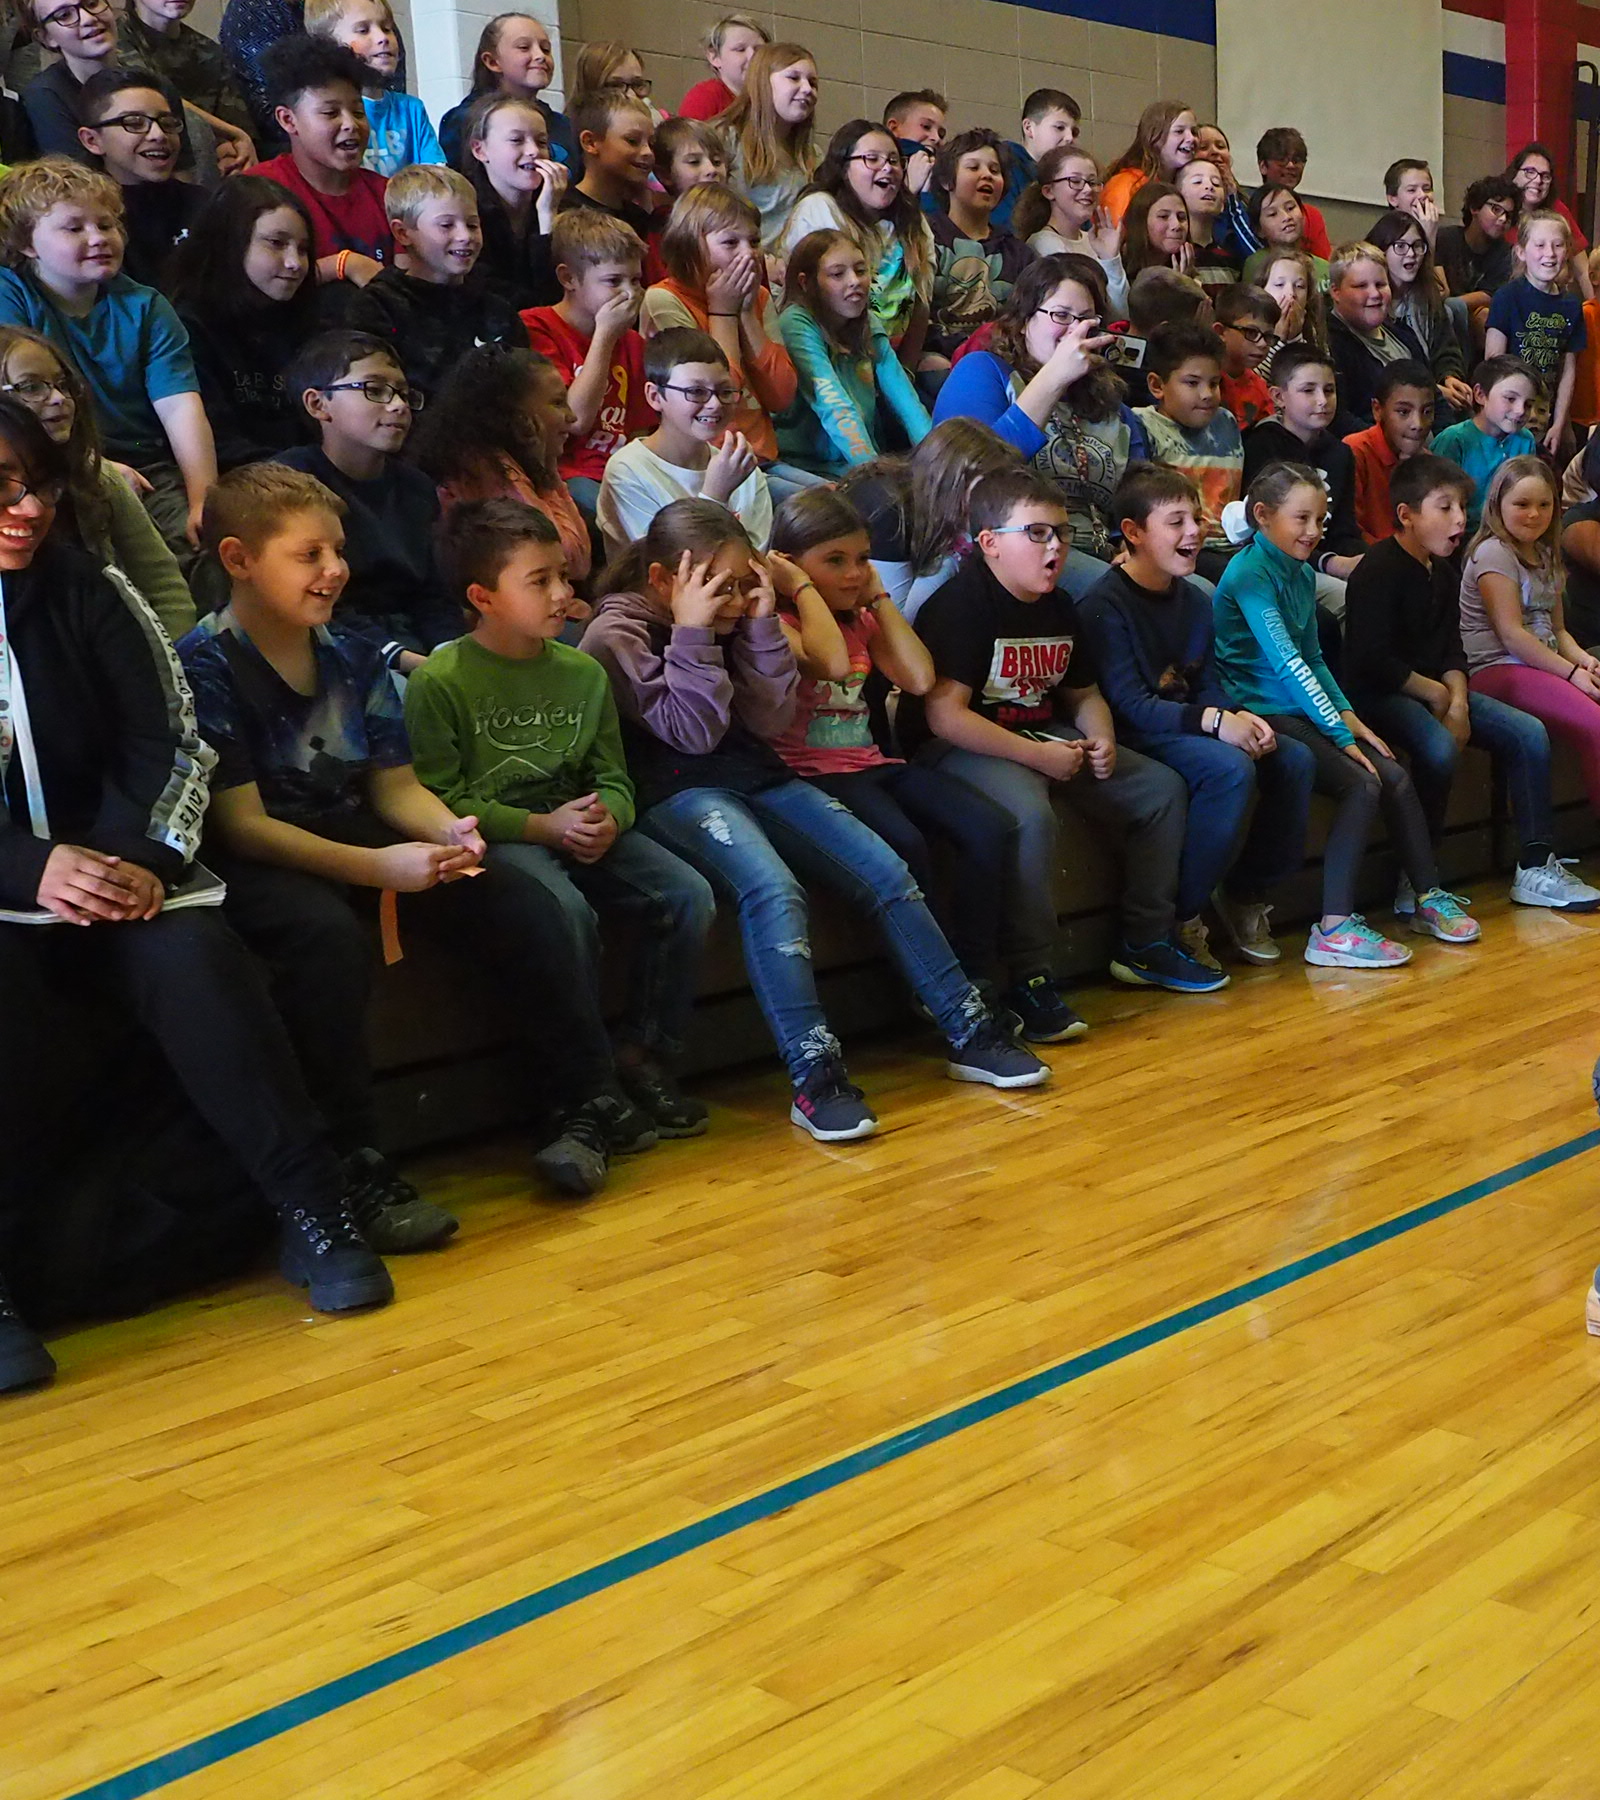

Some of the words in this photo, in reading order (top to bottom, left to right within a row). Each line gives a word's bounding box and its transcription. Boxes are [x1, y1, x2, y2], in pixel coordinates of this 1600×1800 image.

[1000, 643, 1071, 678] BRING
[1285, 656, 1343, 728] ARMOUR
[474, 695, 587, 753] Hockey
